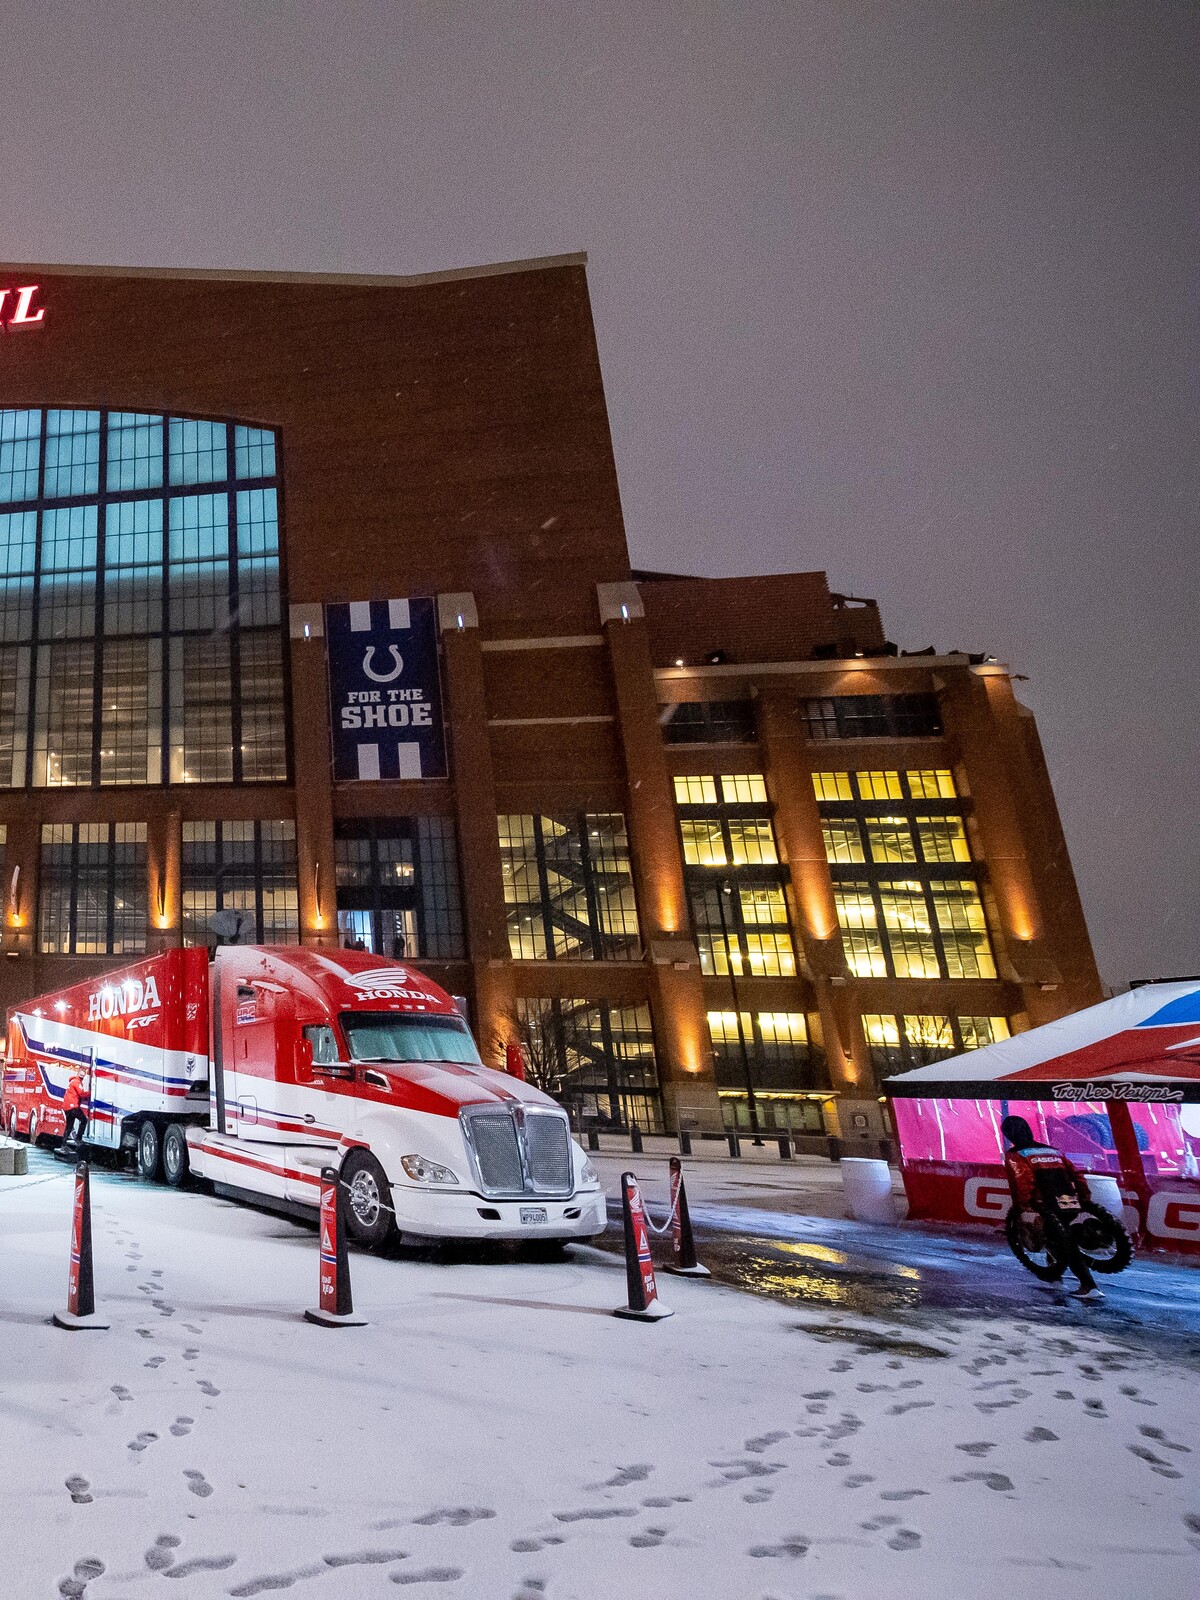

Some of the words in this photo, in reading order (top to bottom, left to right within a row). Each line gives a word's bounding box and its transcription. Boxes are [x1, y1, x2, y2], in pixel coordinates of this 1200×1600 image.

[348, 691, 381, 703] FOR
[387, 689, 423, 701] THE
[341, 703, 433, 729] SHOE
[88, 976, 161, 1022] HONDA
[354, 989, 442, 1004] HONDA
[126, 1014, 160, 1029] CRF
[1052, 1083, 1085, 1101] Troy
[1084, 1083, 1113, 1099] Lee
[1111, 1082, 1184, 1102] Designs
